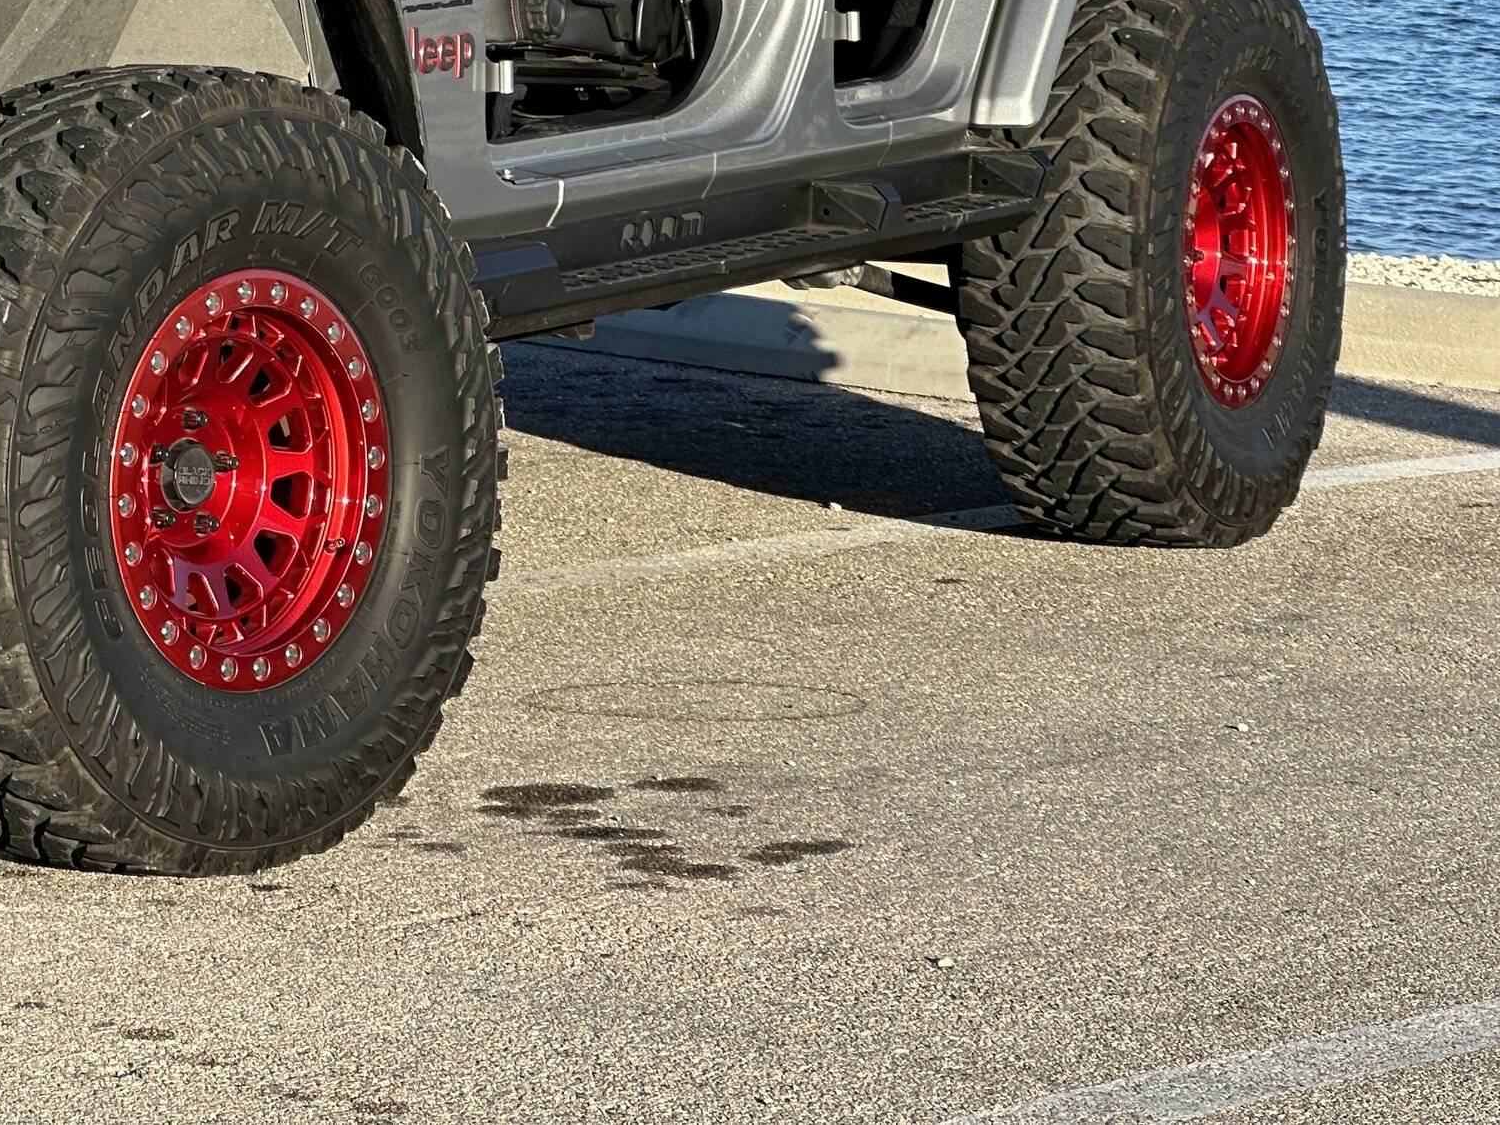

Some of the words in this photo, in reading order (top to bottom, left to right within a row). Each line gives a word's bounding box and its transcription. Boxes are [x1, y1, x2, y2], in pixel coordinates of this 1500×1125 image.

[79, 208, 241, 642] GEOLANDAR
[252, 201, 363, 256] M/T
[258, 445, 448, 757] YOKOHAMA
